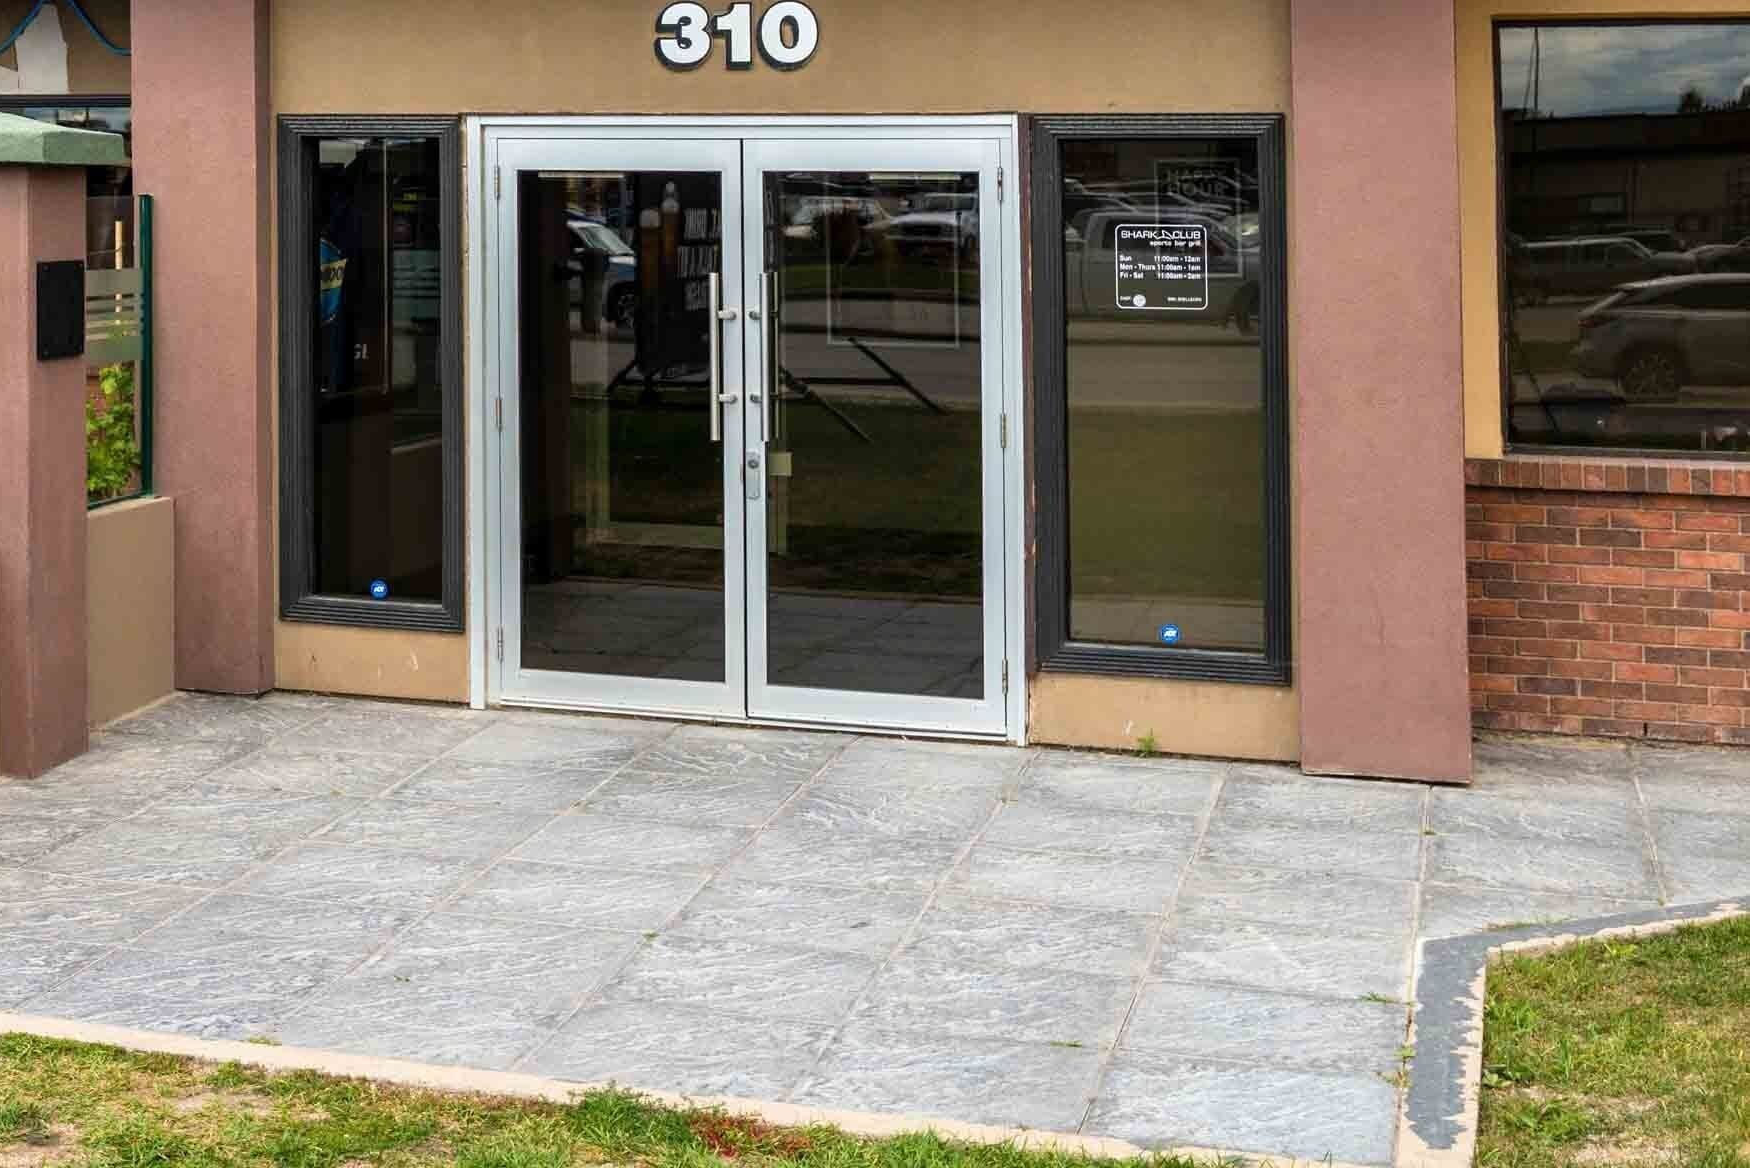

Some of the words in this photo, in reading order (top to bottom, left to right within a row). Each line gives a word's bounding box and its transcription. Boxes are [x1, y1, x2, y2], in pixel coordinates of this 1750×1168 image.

[654, 0, 820, 72] 310
[1120, 230, 1156, 239] SHARK
[1172, 230, 1201, 240] CLUB
